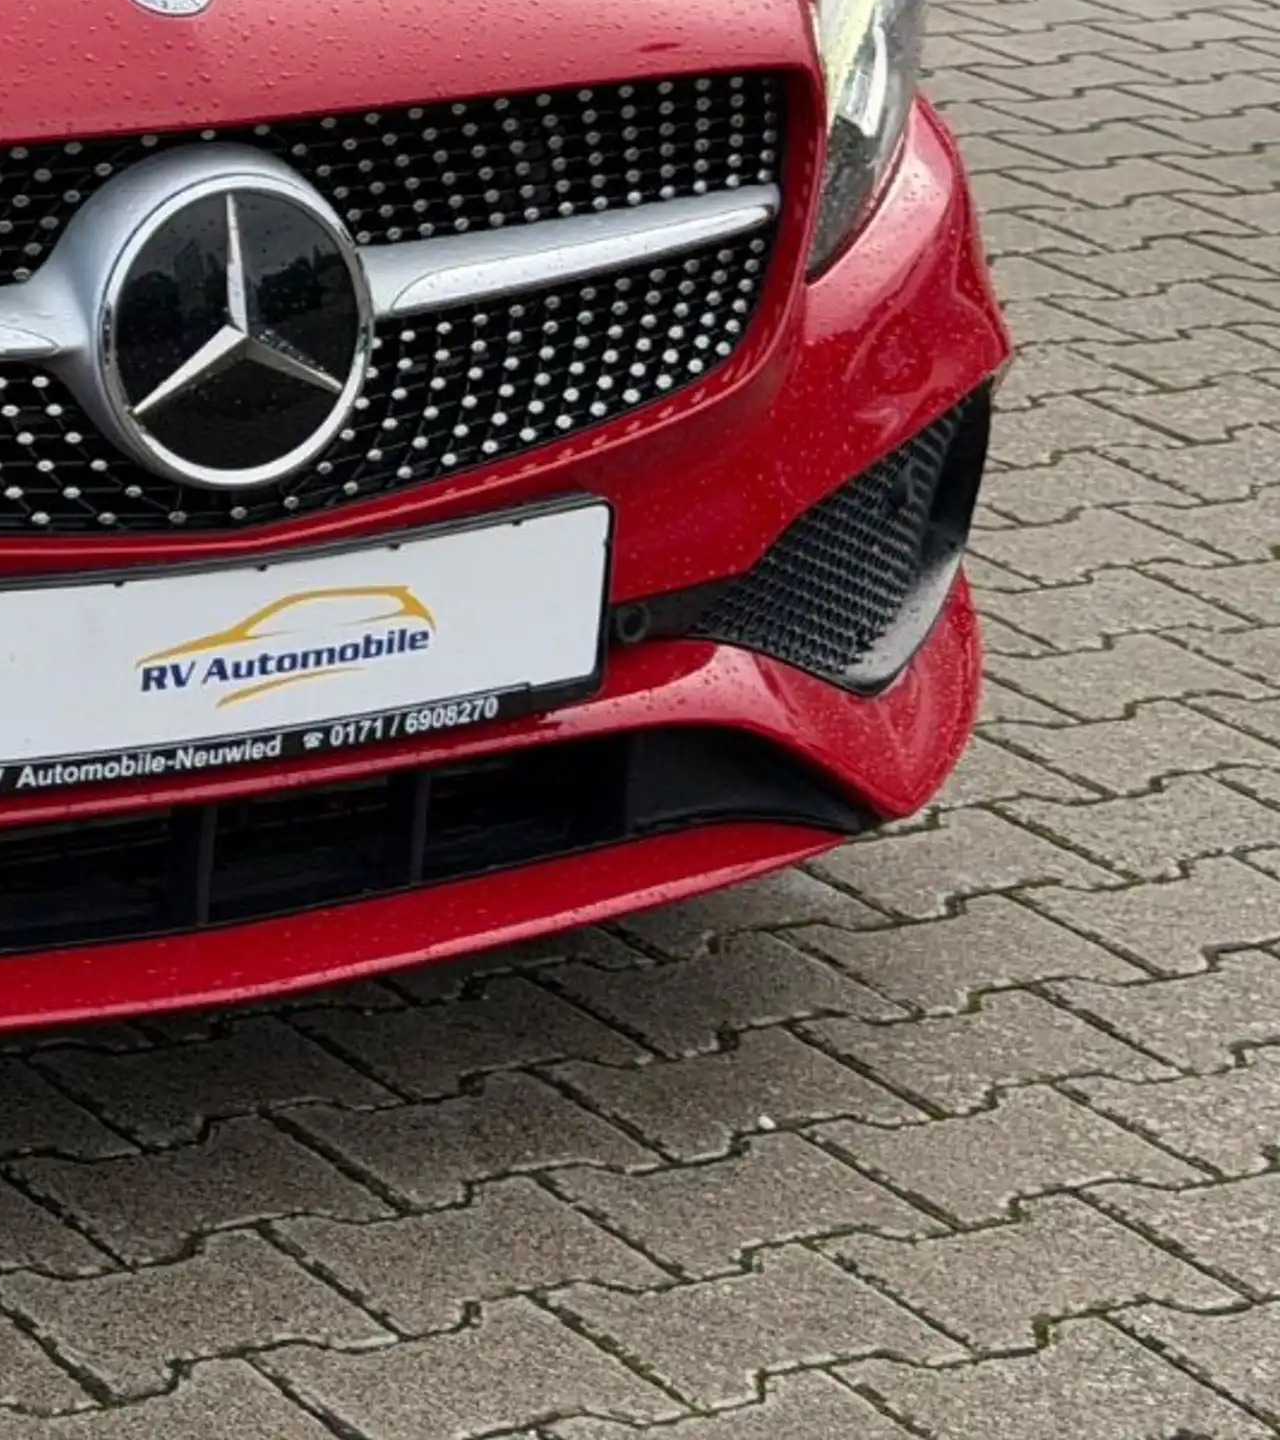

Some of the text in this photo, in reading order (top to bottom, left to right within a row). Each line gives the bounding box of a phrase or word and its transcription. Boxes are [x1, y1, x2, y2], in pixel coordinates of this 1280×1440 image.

[141, 628, 430, 692] RV Automobile
[16, 734, 282, 789] Automobile-Neuwied
[329, 719, 384, 747] 0171
[404, 697, 499, 734] 6908270
